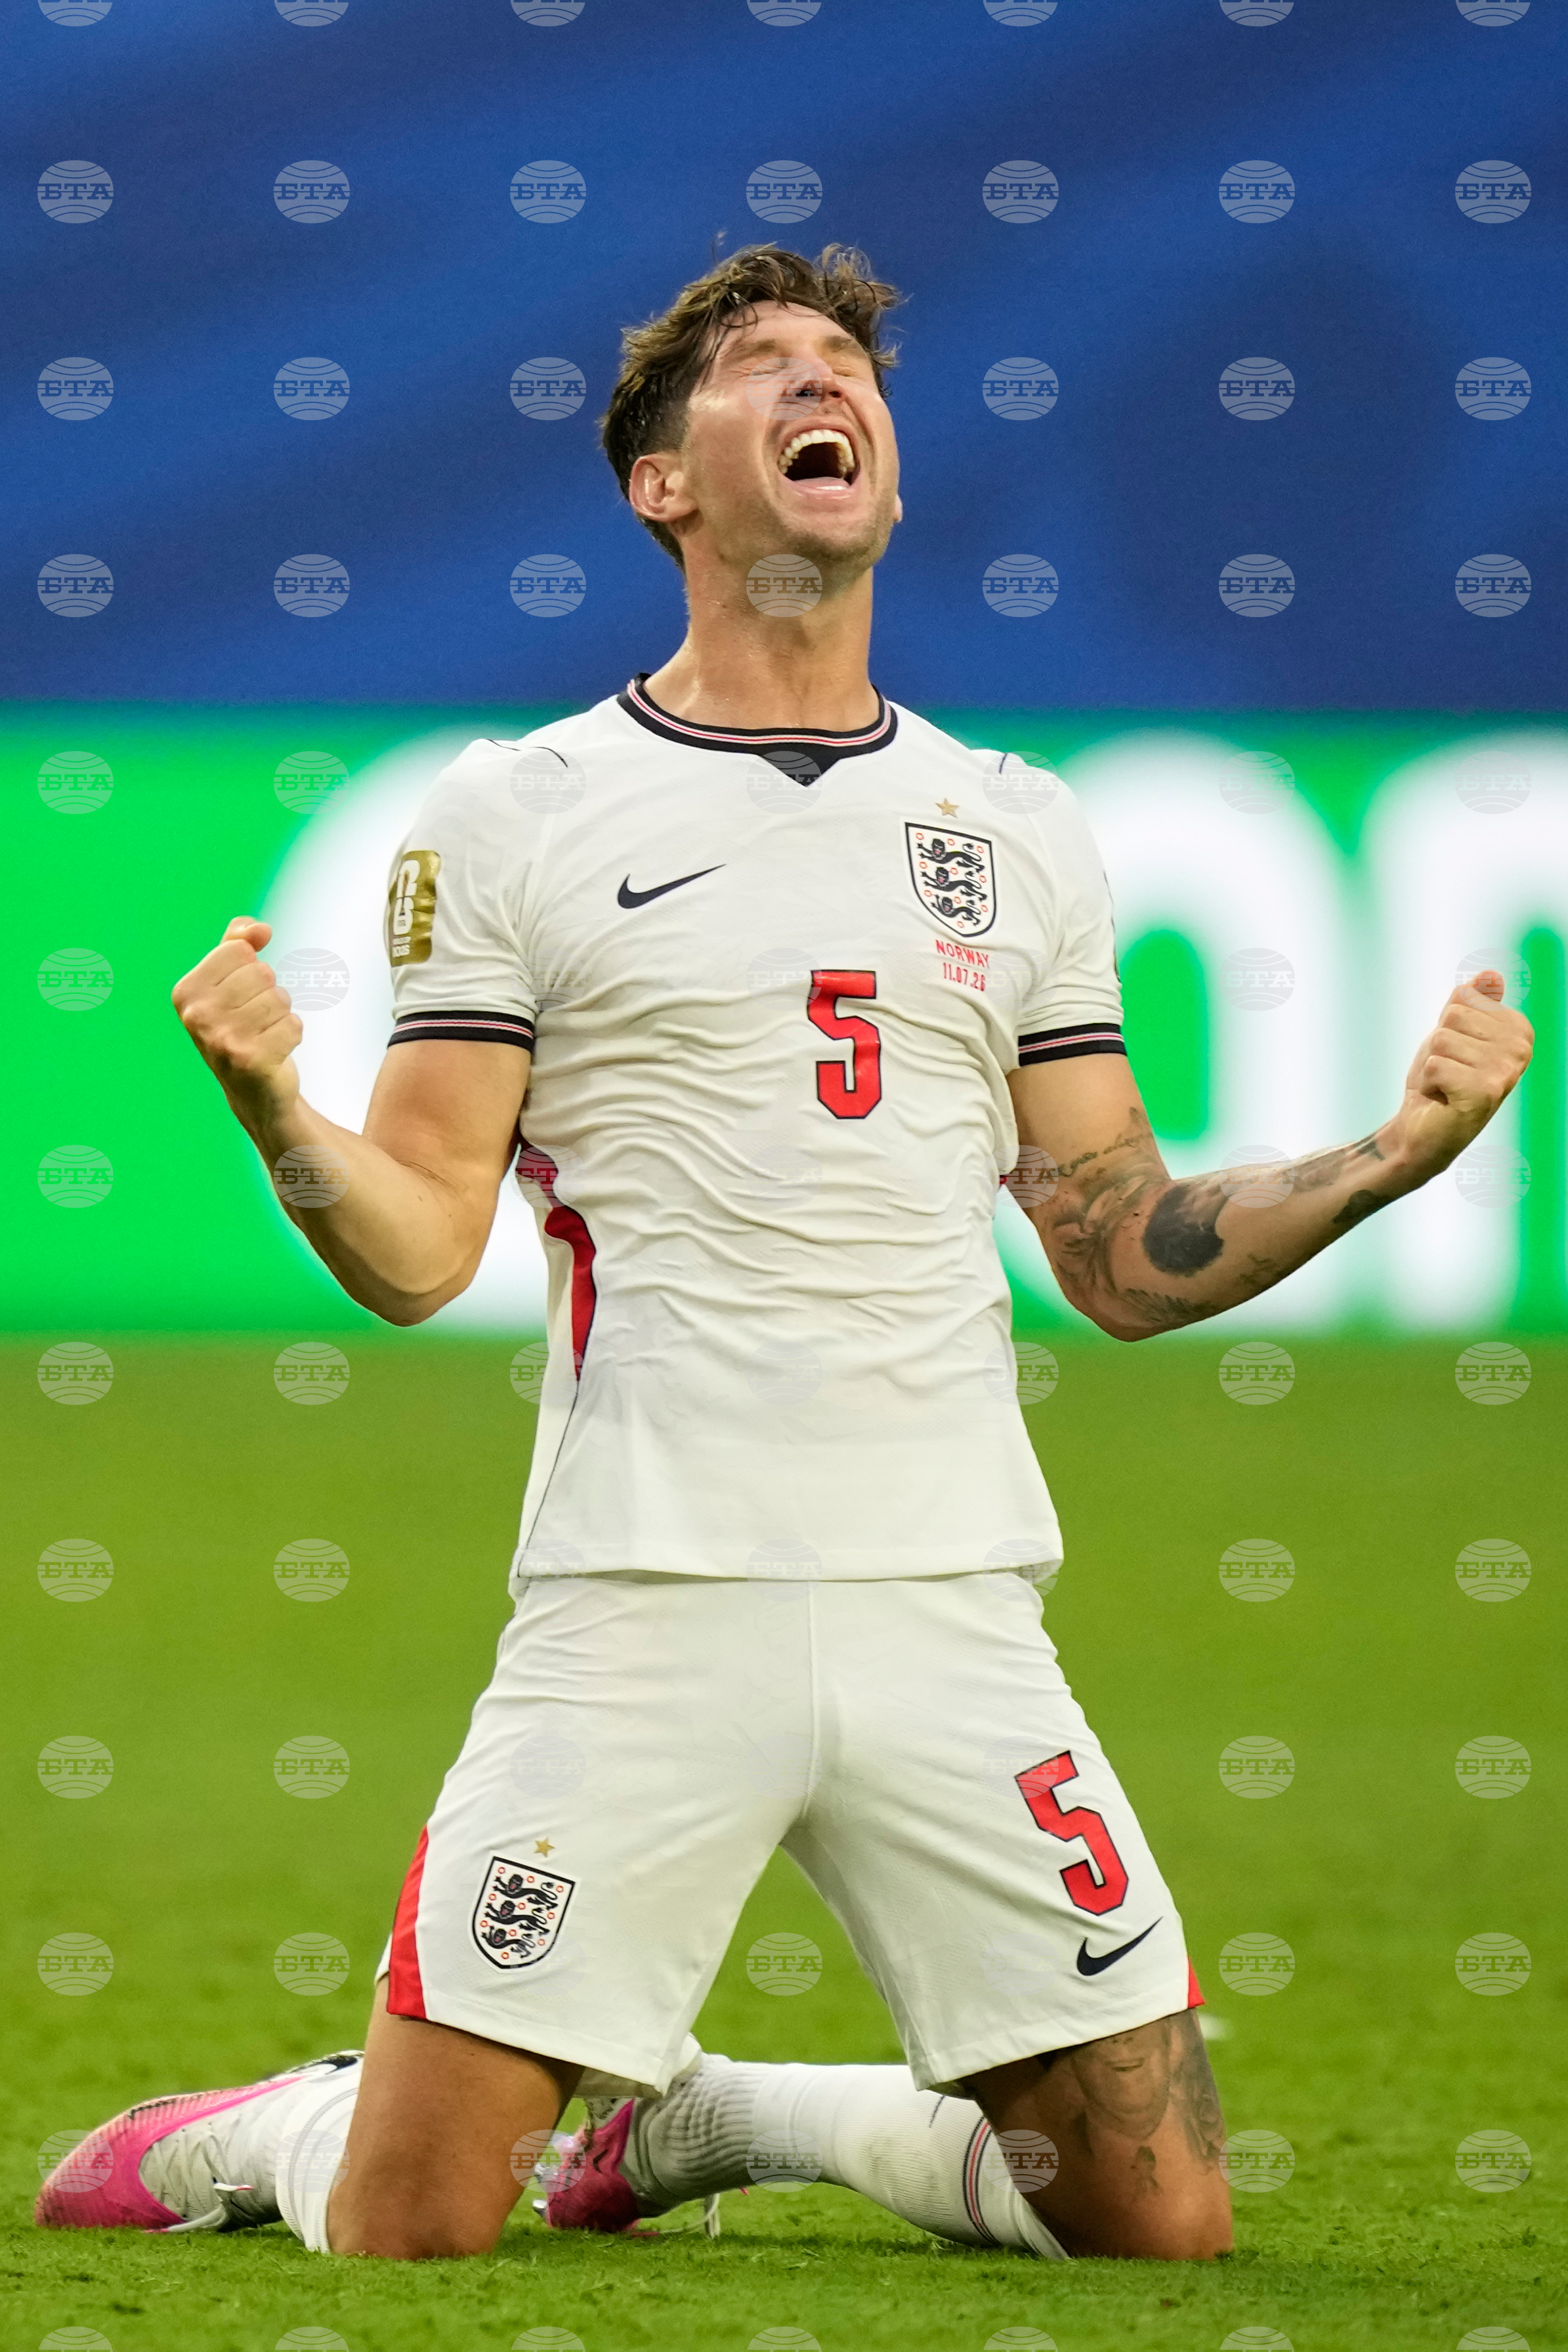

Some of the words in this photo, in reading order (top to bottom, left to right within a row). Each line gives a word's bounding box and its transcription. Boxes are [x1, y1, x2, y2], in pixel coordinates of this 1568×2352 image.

[935, 939, 990, 969] NORWAY
[943, 962, 986, 991] 11.07.26
[807, 969, 881, 1119] 5
[1014, 1750, 1129, 1916] 5
